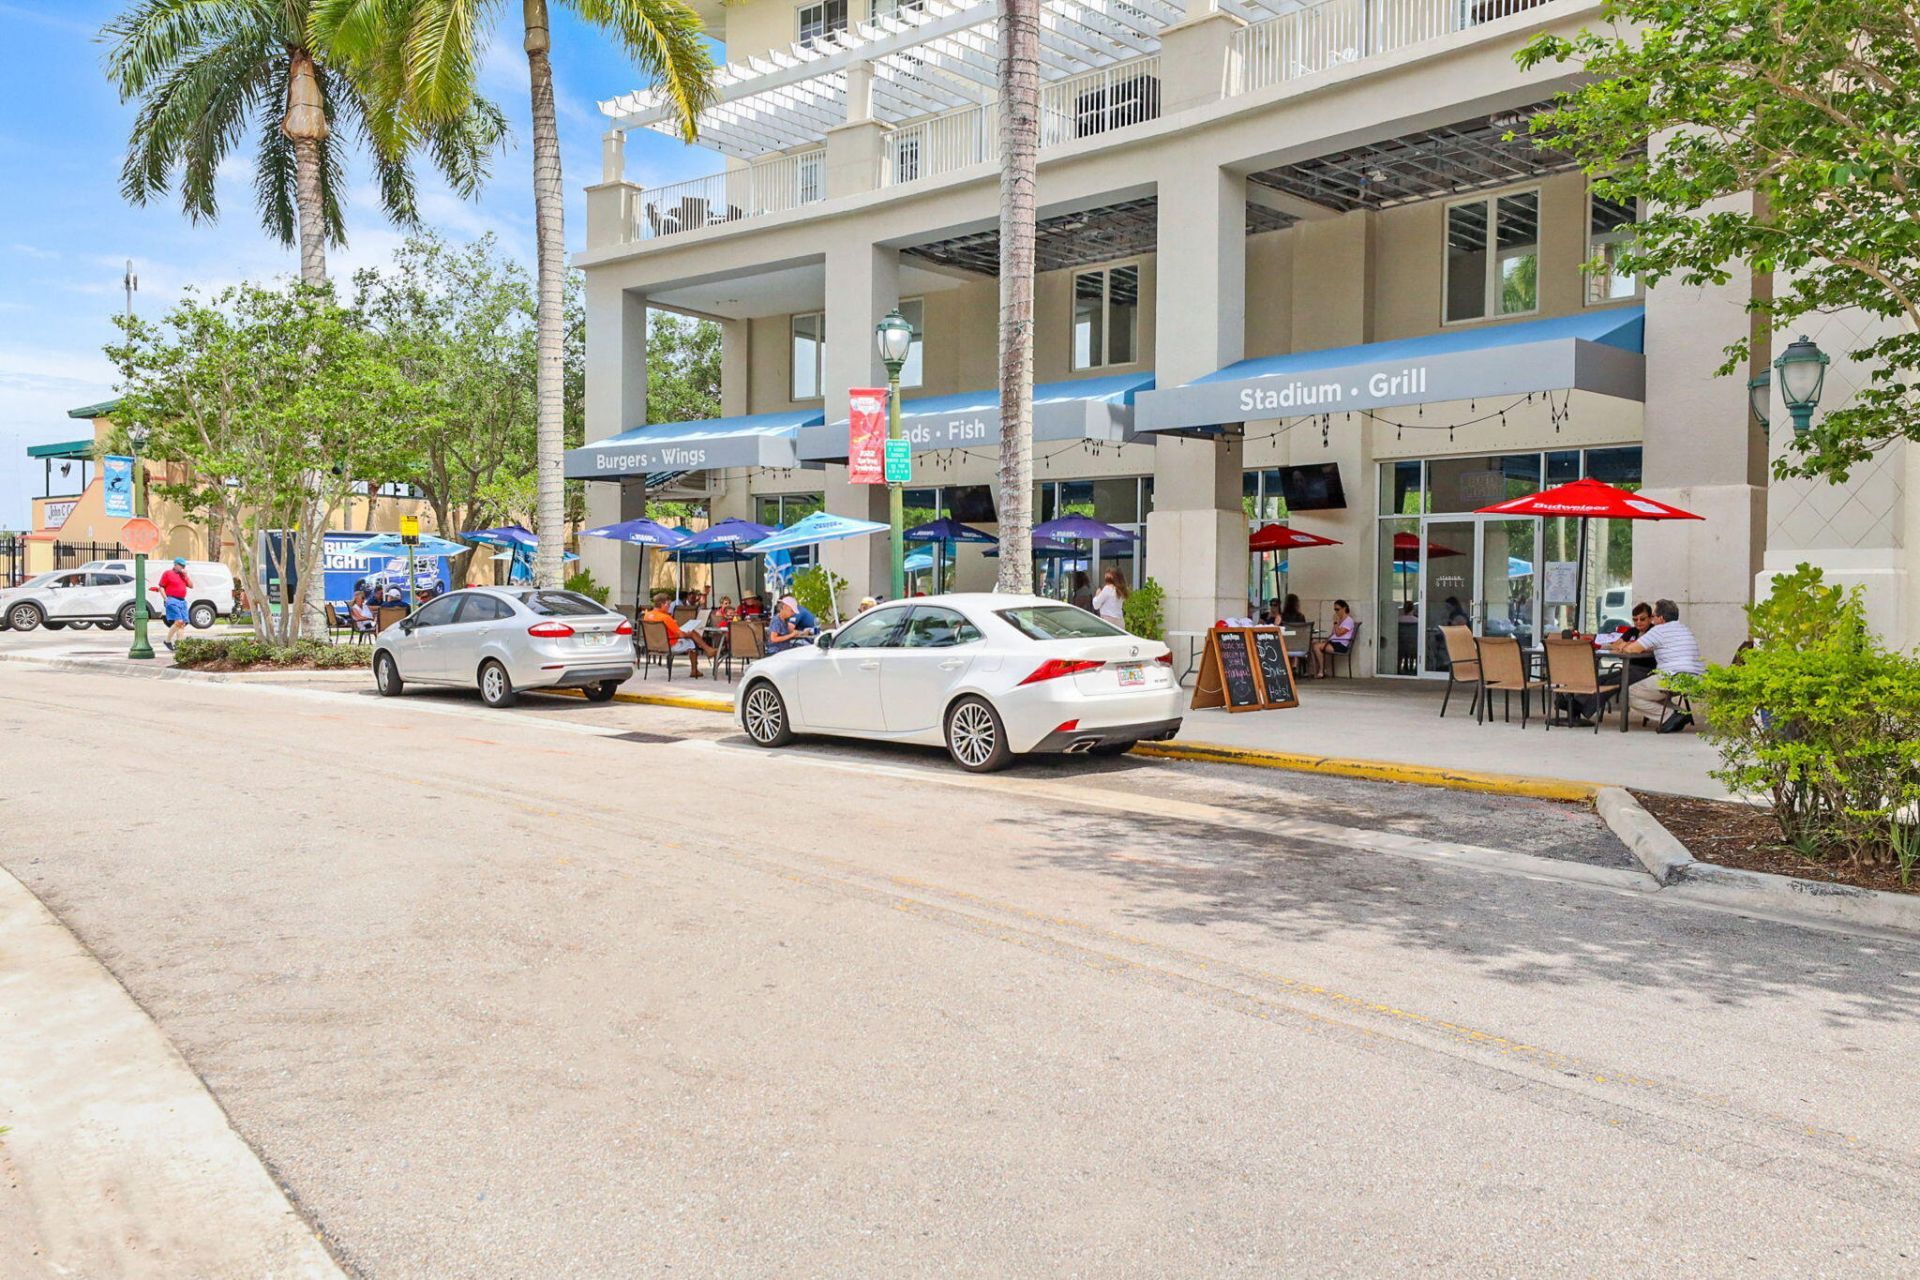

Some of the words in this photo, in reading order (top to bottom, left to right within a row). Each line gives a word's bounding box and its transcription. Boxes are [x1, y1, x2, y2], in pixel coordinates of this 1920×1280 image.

[1239, 382, 1341, 411] Stadium
[1368, 367, 1426, 398] Grill
[900, 423, 931, 444] ads
[948, 418, 985, 441] Fish
[596, 453, 648, 471] Burgers
[661, 448, 706, 467] Wings
[1532, 502, 1609, 513] Budweiser
[123, 529, 157, 544] STOP
